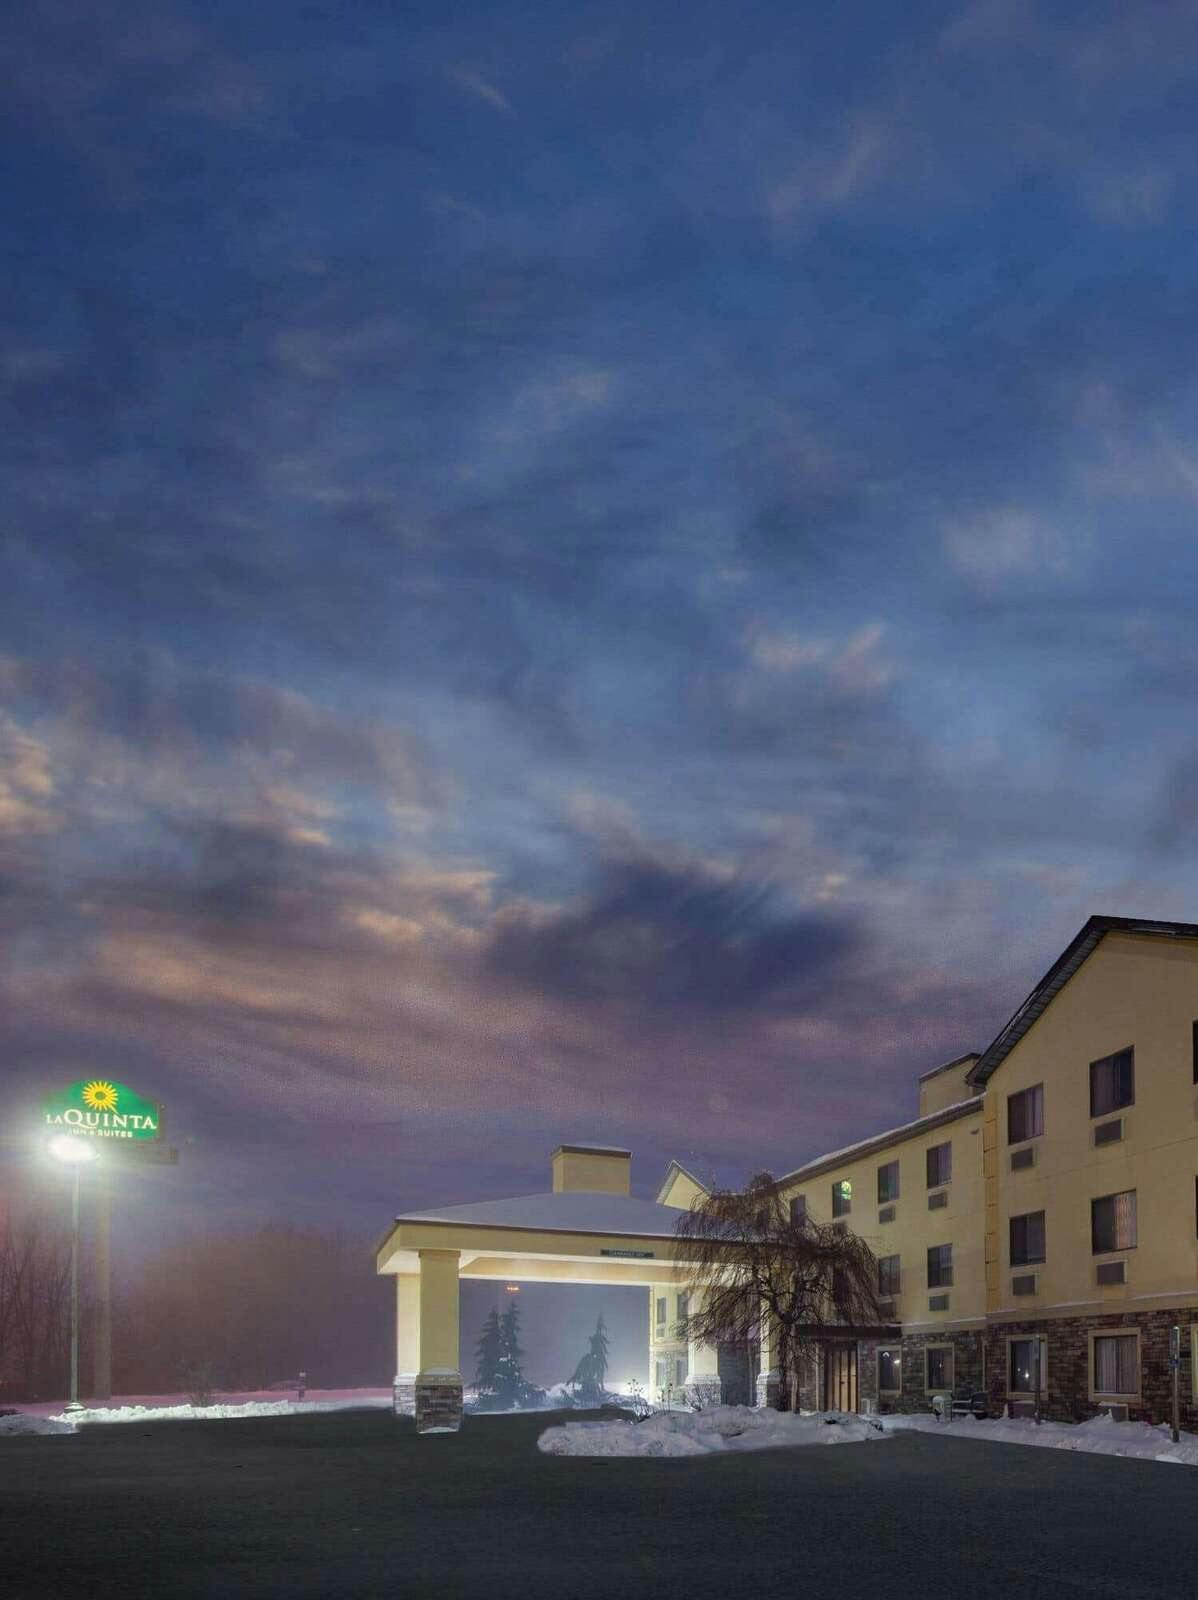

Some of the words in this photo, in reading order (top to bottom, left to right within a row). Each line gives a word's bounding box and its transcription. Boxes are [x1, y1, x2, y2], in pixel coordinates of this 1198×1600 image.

[46, 1113, 63, 1124] LA
[64, 1108, 157, 1129] QUINTA
[98, 1129, 133, 1138] SUITES
